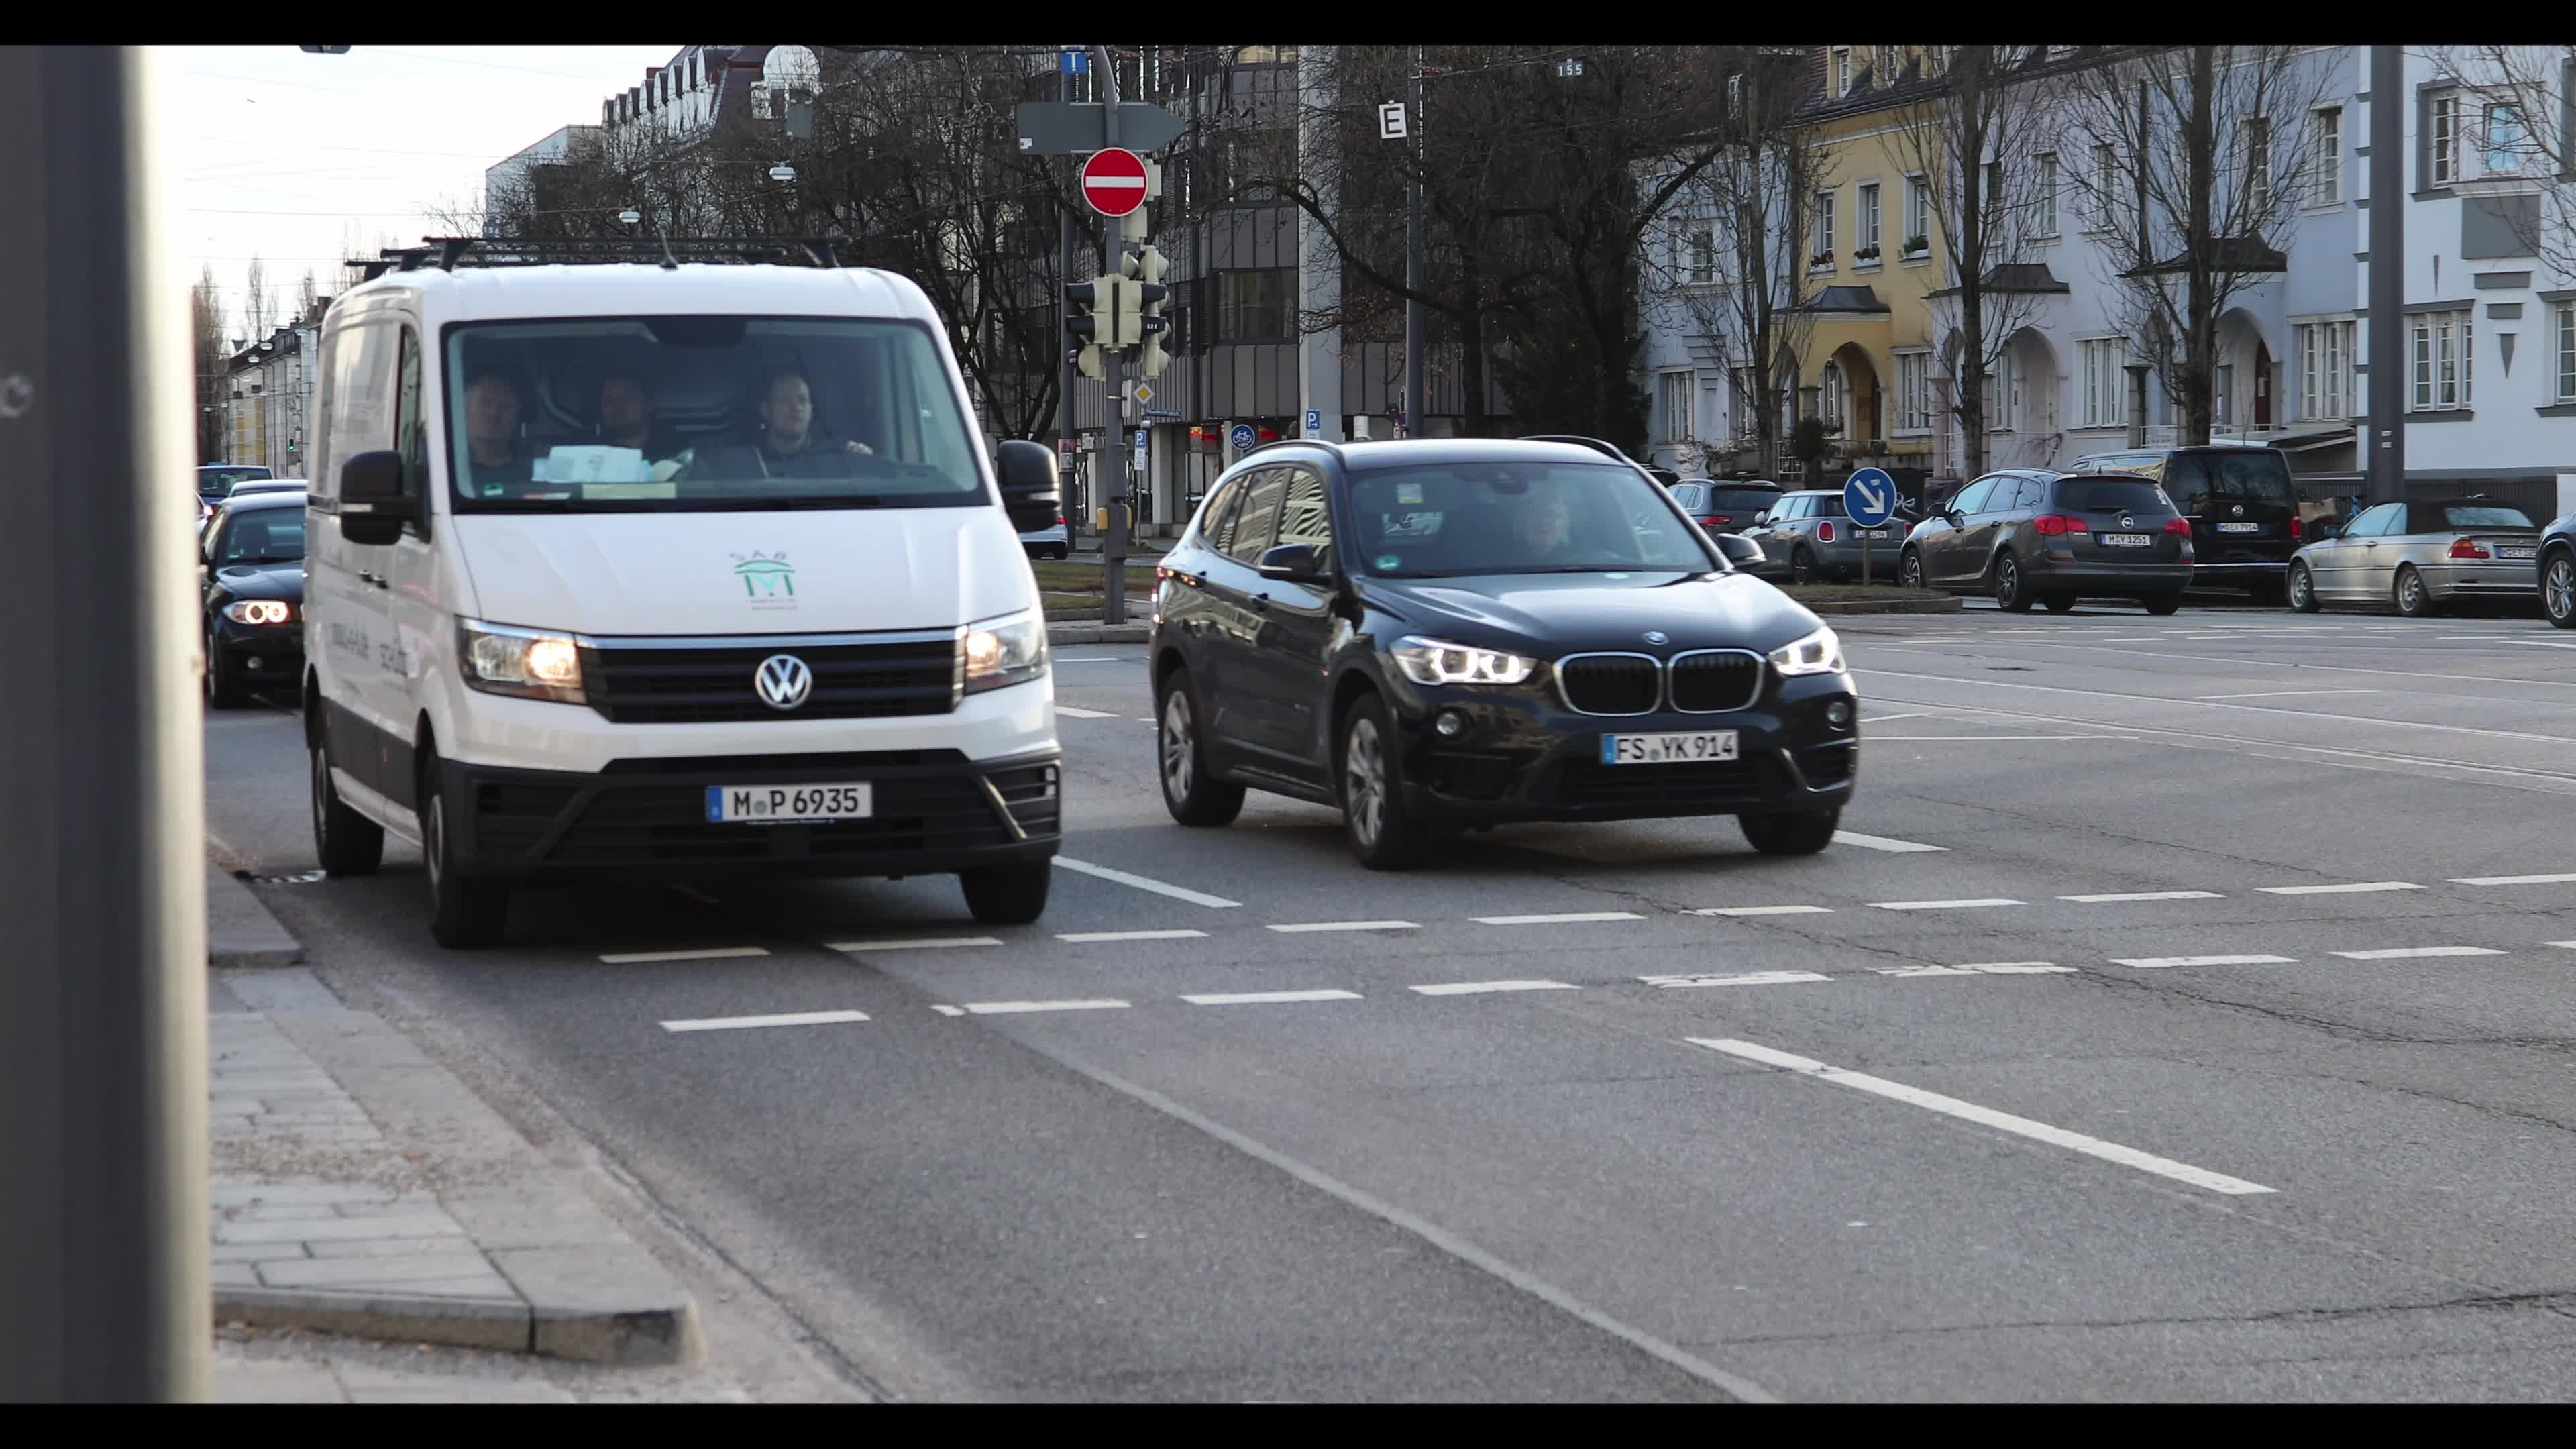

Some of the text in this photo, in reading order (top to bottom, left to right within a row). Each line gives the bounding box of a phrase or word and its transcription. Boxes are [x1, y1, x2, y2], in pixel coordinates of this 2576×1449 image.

[1558, 64, 1582, 76] 155
[1384, 107, 1403, 135] E
[1308, 412, 1317, 427] P
[1136, 433, 1144, 446] P
[2109, 535, 2115, 543] M
[2128, 535, 2147, 544] 1251
[1616, 735, 1734, 760] FS YK 914
[733, 788, 859, 816] M P 6935
